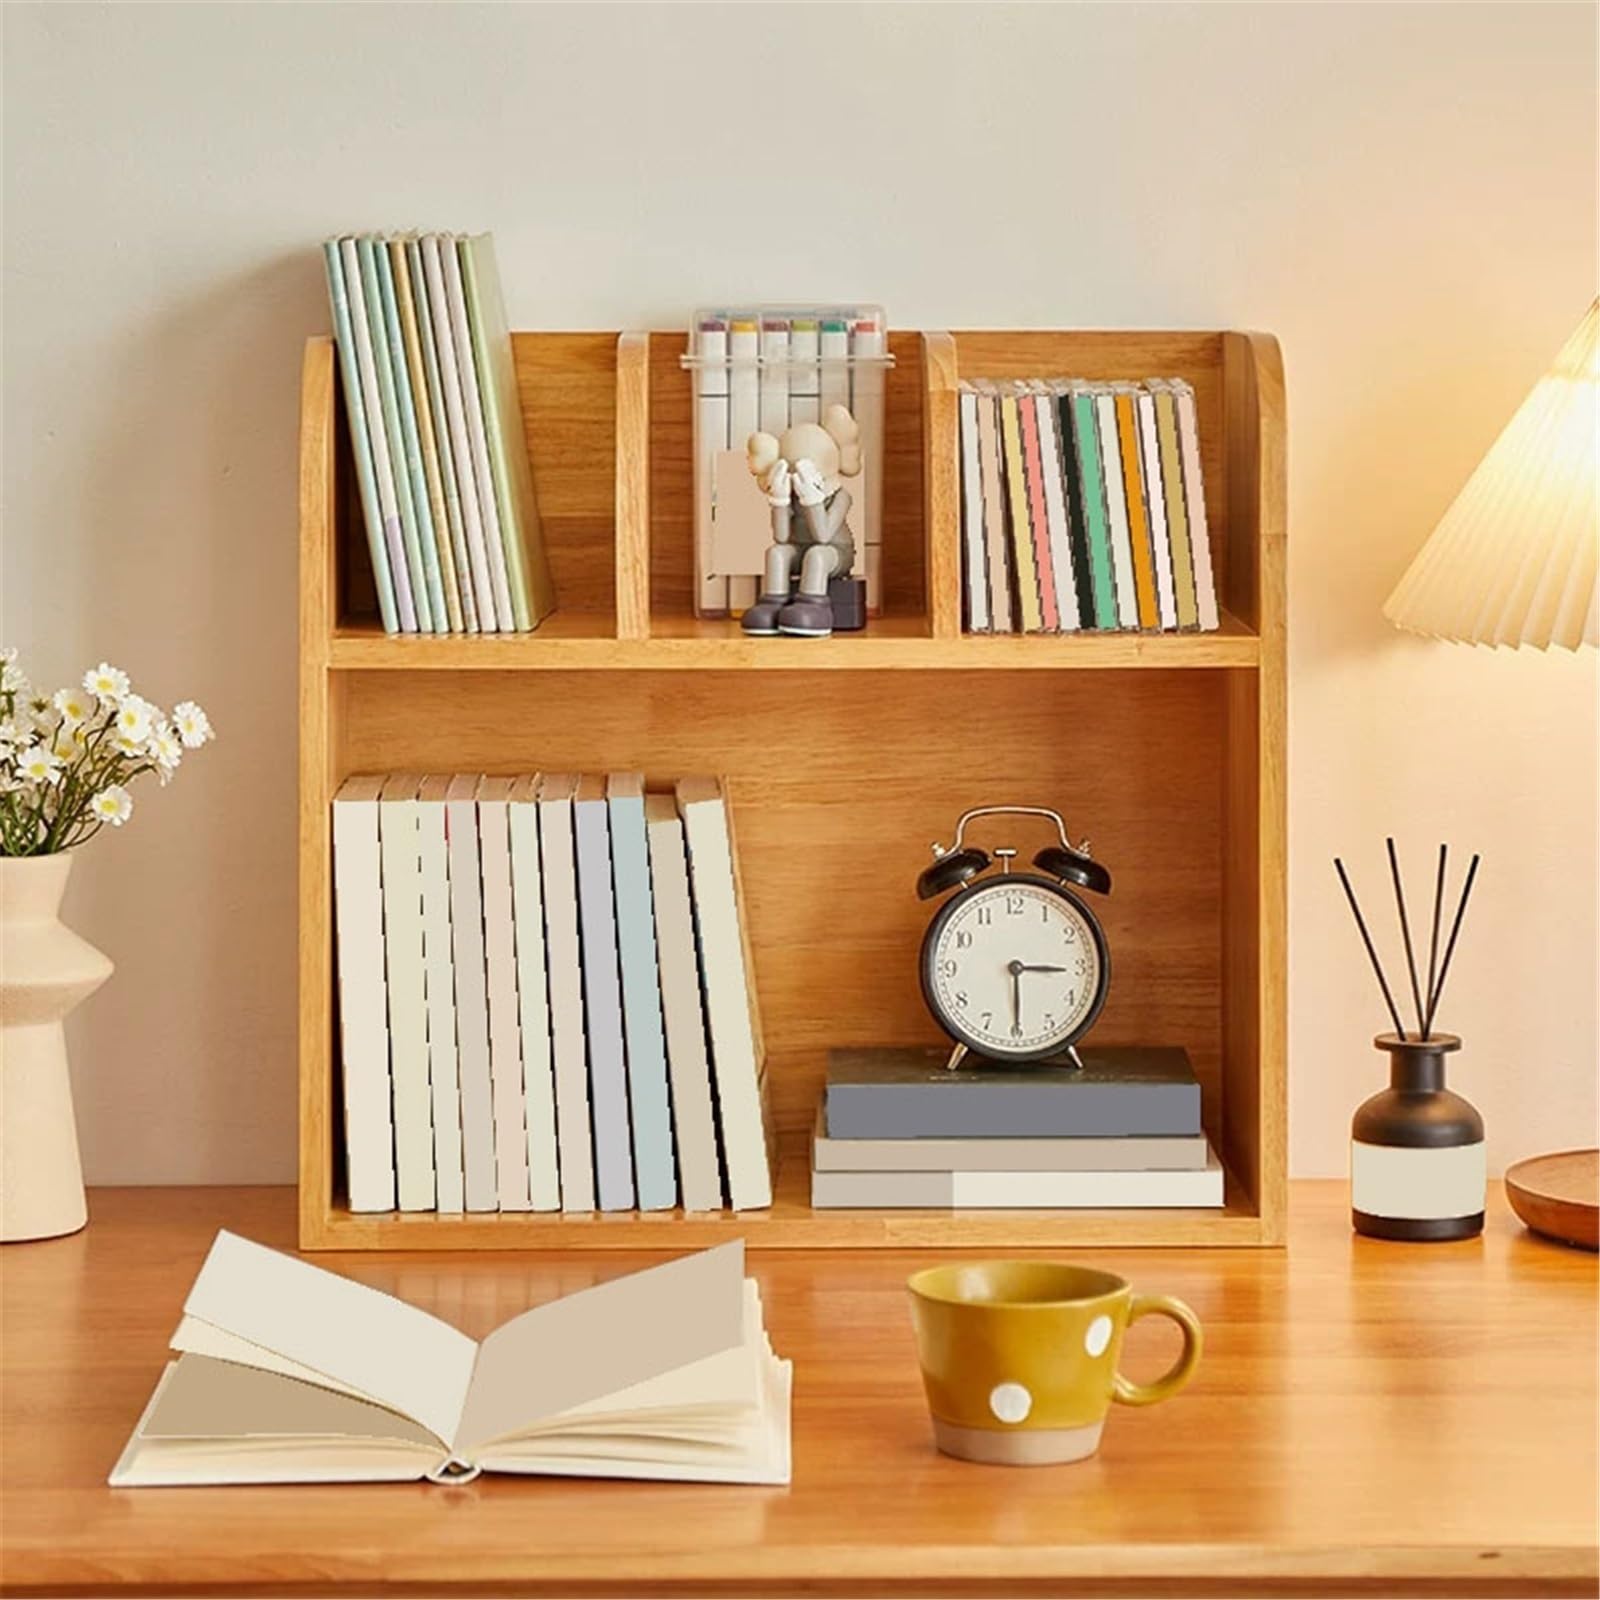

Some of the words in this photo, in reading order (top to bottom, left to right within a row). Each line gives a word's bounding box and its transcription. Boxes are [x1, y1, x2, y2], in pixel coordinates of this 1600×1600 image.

[1006, 897, 1024, 915] 12
[1041, 905, 1048, 923] 1
[977, 907, 991, 925] 11
[956, 931, 973, 948] 10
[1064, 927, 1075, 944] 2
[945, 960, 957, 978] 9
[1075, 959, 1086, 976] 3
[955, 992, 968, 1008] 8
[1064, 989, 1074, 1006] 4
[981, 1012, 992, 1030] 7
[1043, 1014, 1055, 1031] 5
